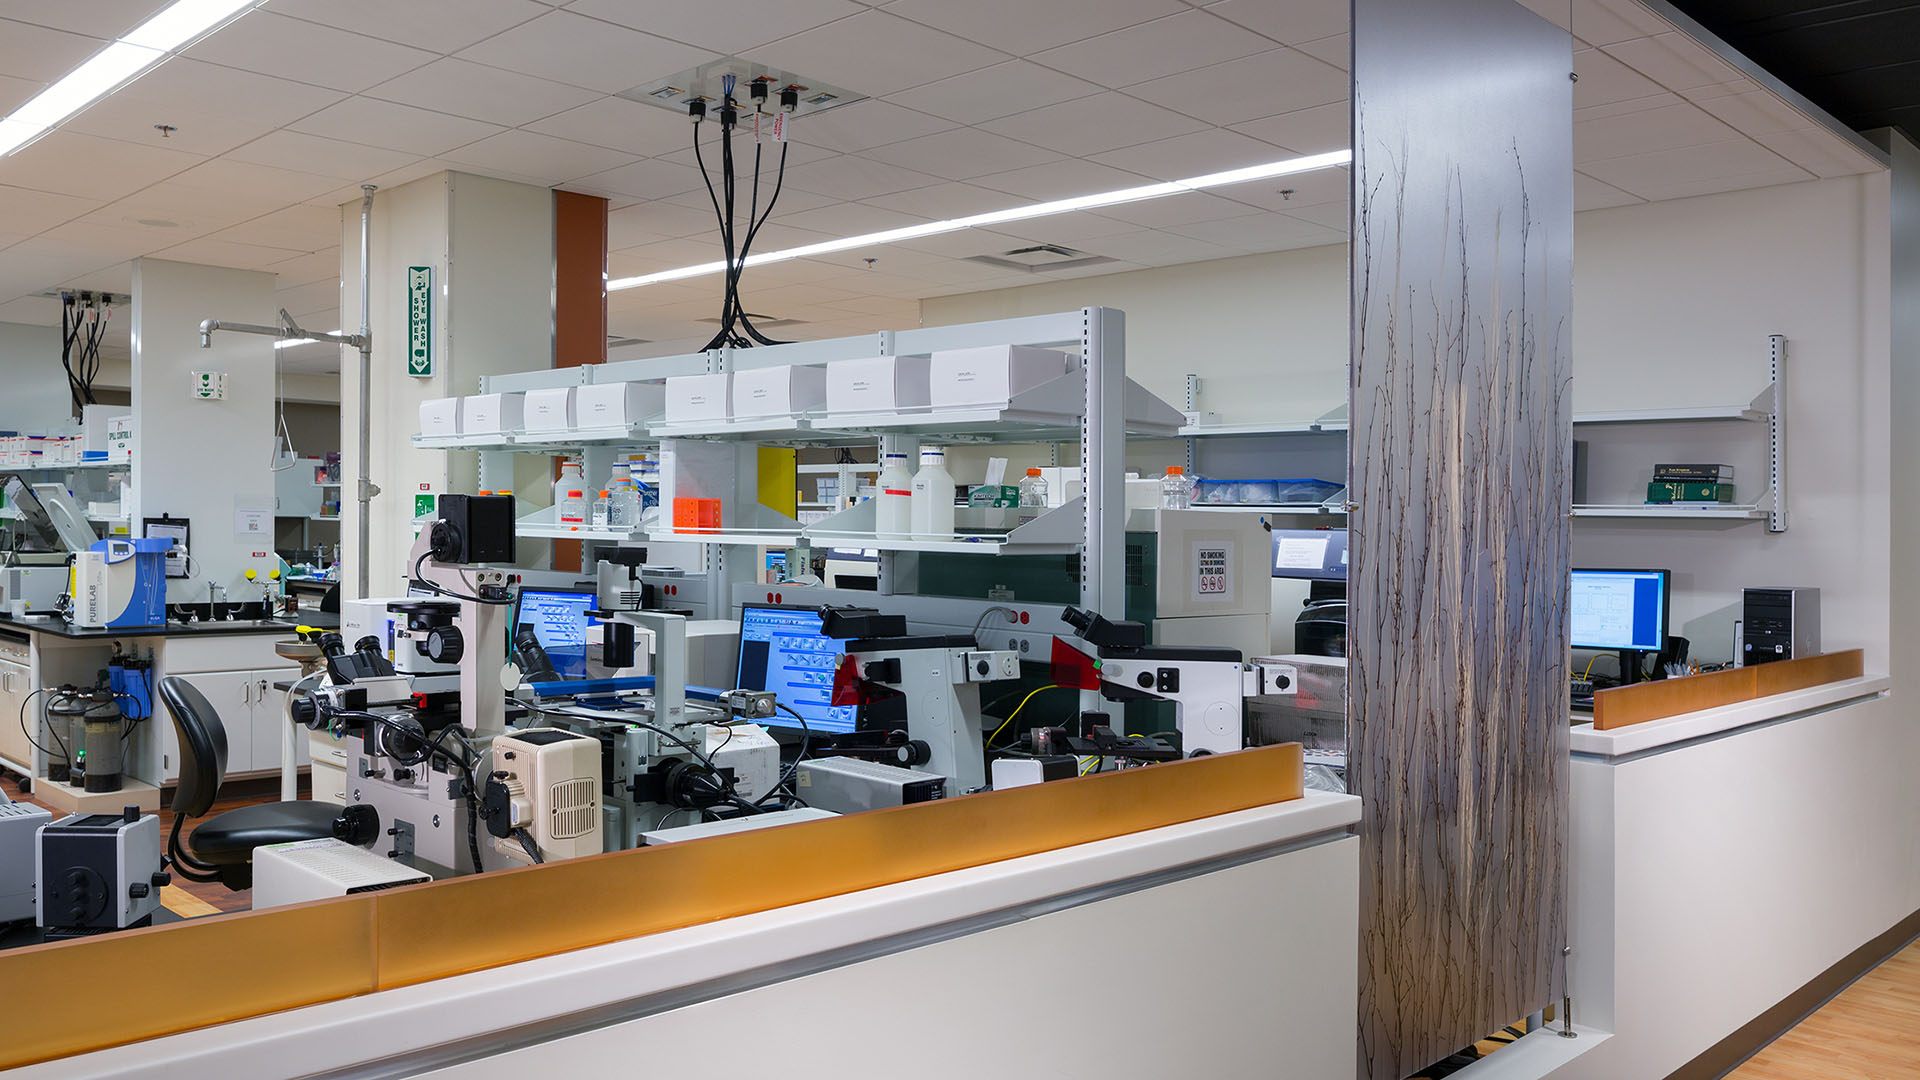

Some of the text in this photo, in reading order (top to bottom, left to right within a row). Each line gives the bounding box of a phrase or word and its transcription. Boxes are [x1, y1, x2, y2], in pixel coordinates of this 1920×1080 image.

[1200, 551, 1225, 559] NO SMOKING
[1199, 567, 1224, 575] IN THIS AREA
[89, 584, 97, 623] PURELAB
